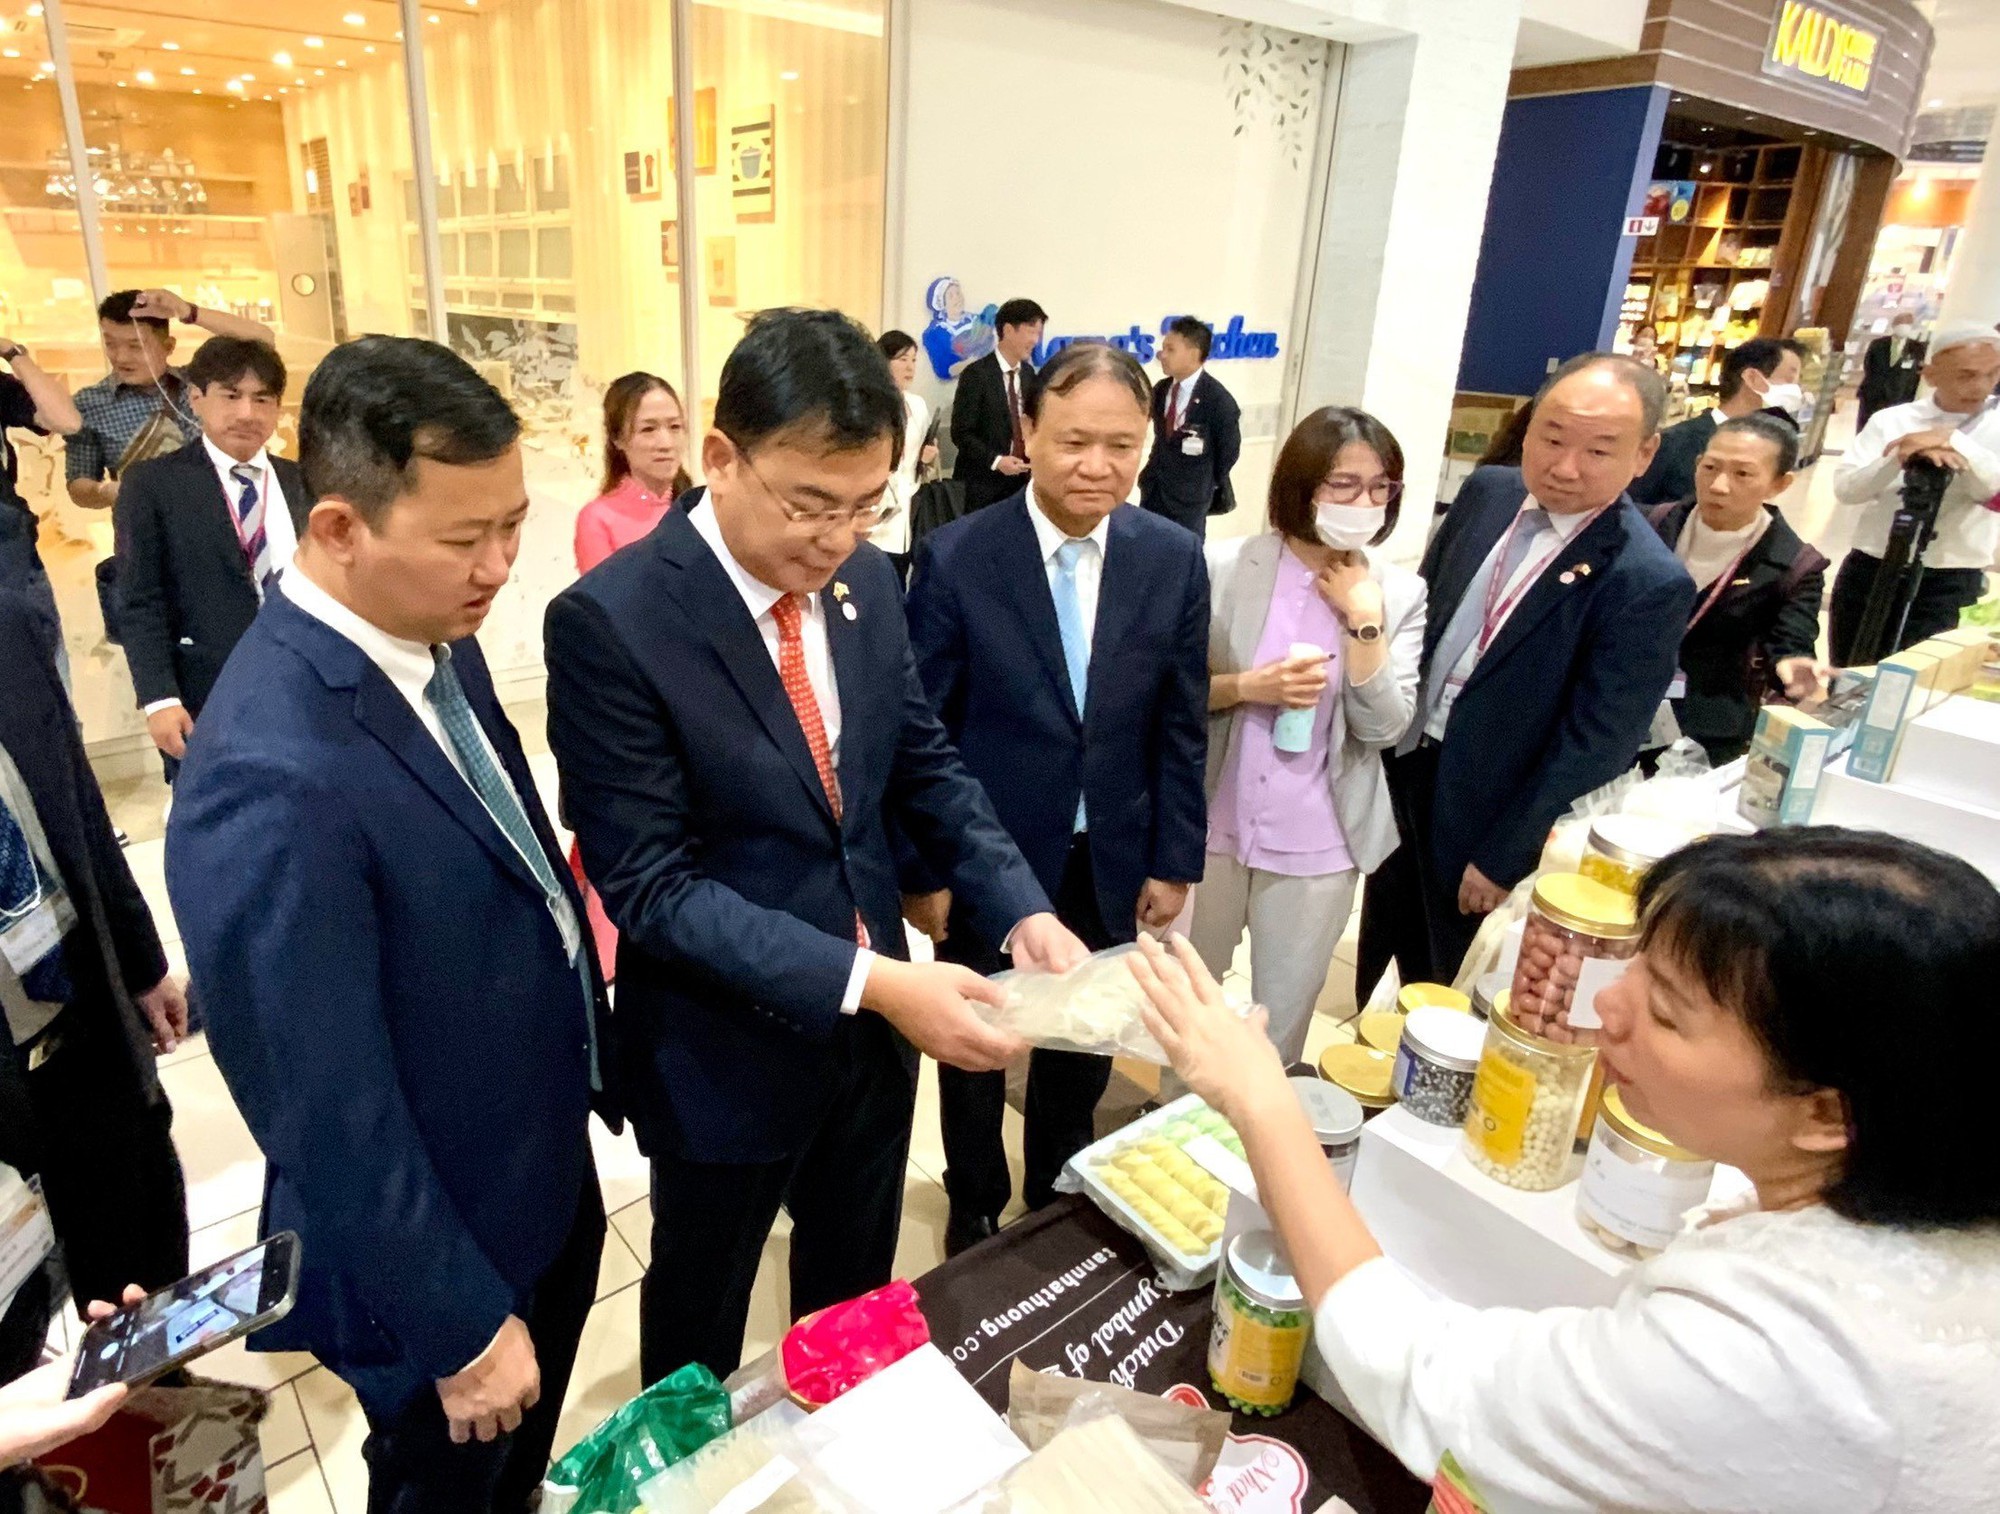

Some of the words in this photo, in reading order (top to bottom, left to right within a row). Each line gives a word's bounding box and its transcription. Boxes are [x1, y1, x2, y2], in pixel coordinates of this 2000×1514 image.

[1772, 1, 1848, 82] KALDI
[944, 1247, 1117, 1366] tannhathuong.co
[1065, 1342, 1090, 1379] of
[1109, 1319, 1184, 1390] Dutch
